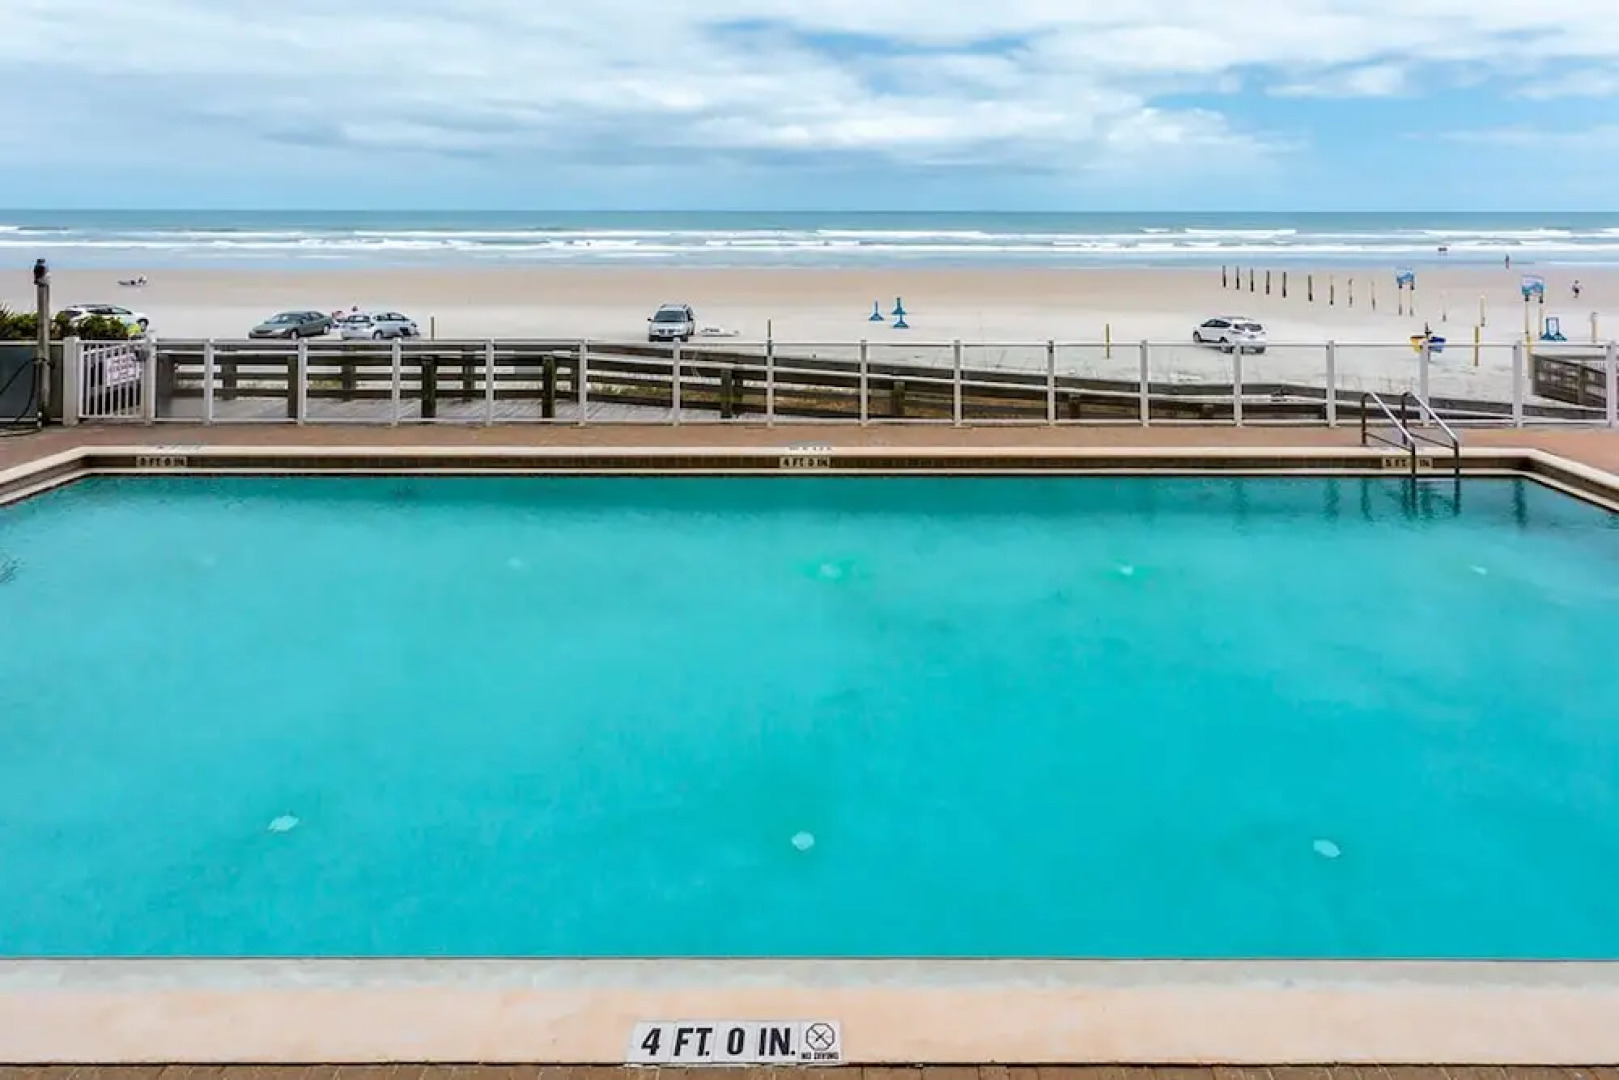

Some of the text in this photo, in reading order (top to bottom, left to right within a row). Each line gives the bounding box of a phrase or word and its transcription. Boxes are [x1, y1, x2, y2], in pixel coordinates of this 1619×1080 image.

[641, 1027, 796, 1056] 4 FT. 0 IN.
[801, 1052, 839, 1060] NO DIVING
